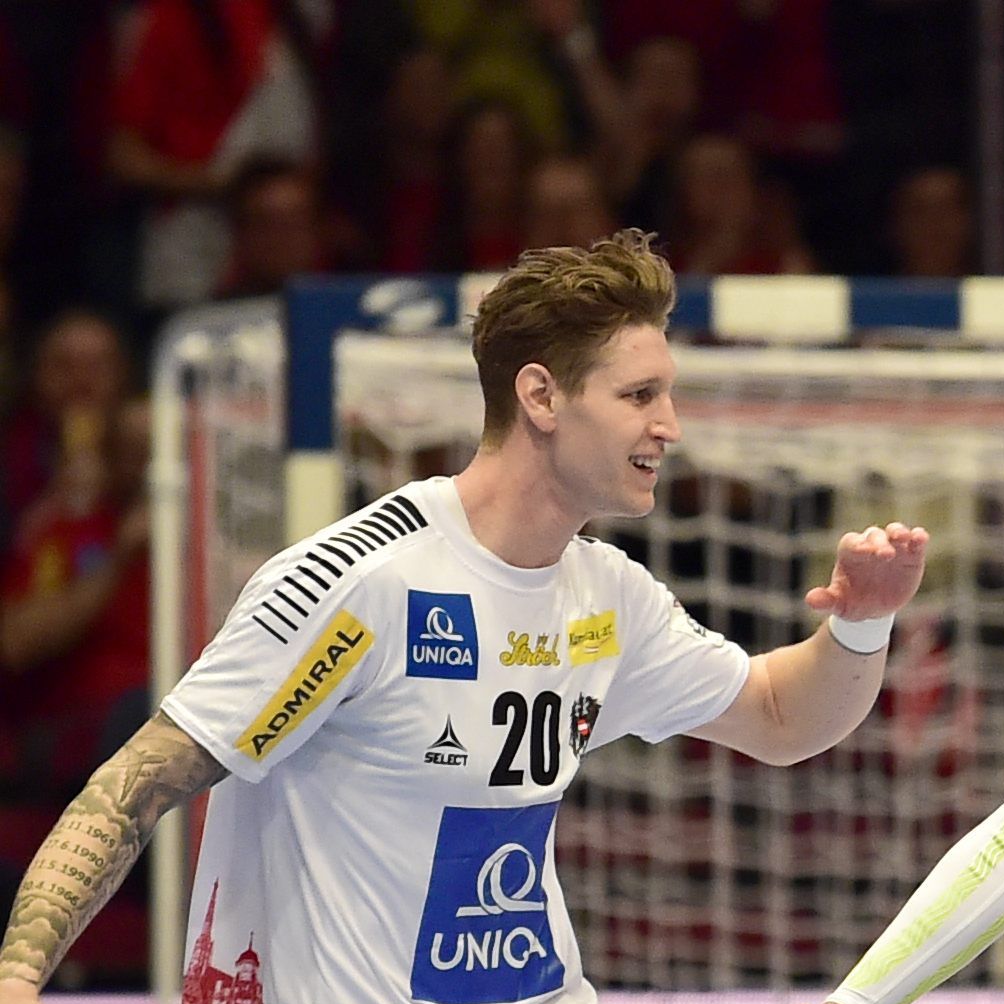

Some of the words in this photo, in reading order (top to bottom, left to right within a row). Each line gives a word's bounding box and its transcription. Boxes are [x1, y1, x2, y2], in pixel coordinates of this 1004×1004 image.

[413, 645, 473, 666] UNIQA
[252, 630, 364, 756] ADMIRAL
[424, 752, 468, 766] SELECT
[489, 691, 562, 787] 20
[430, 926, 547, 972] UNIQA
